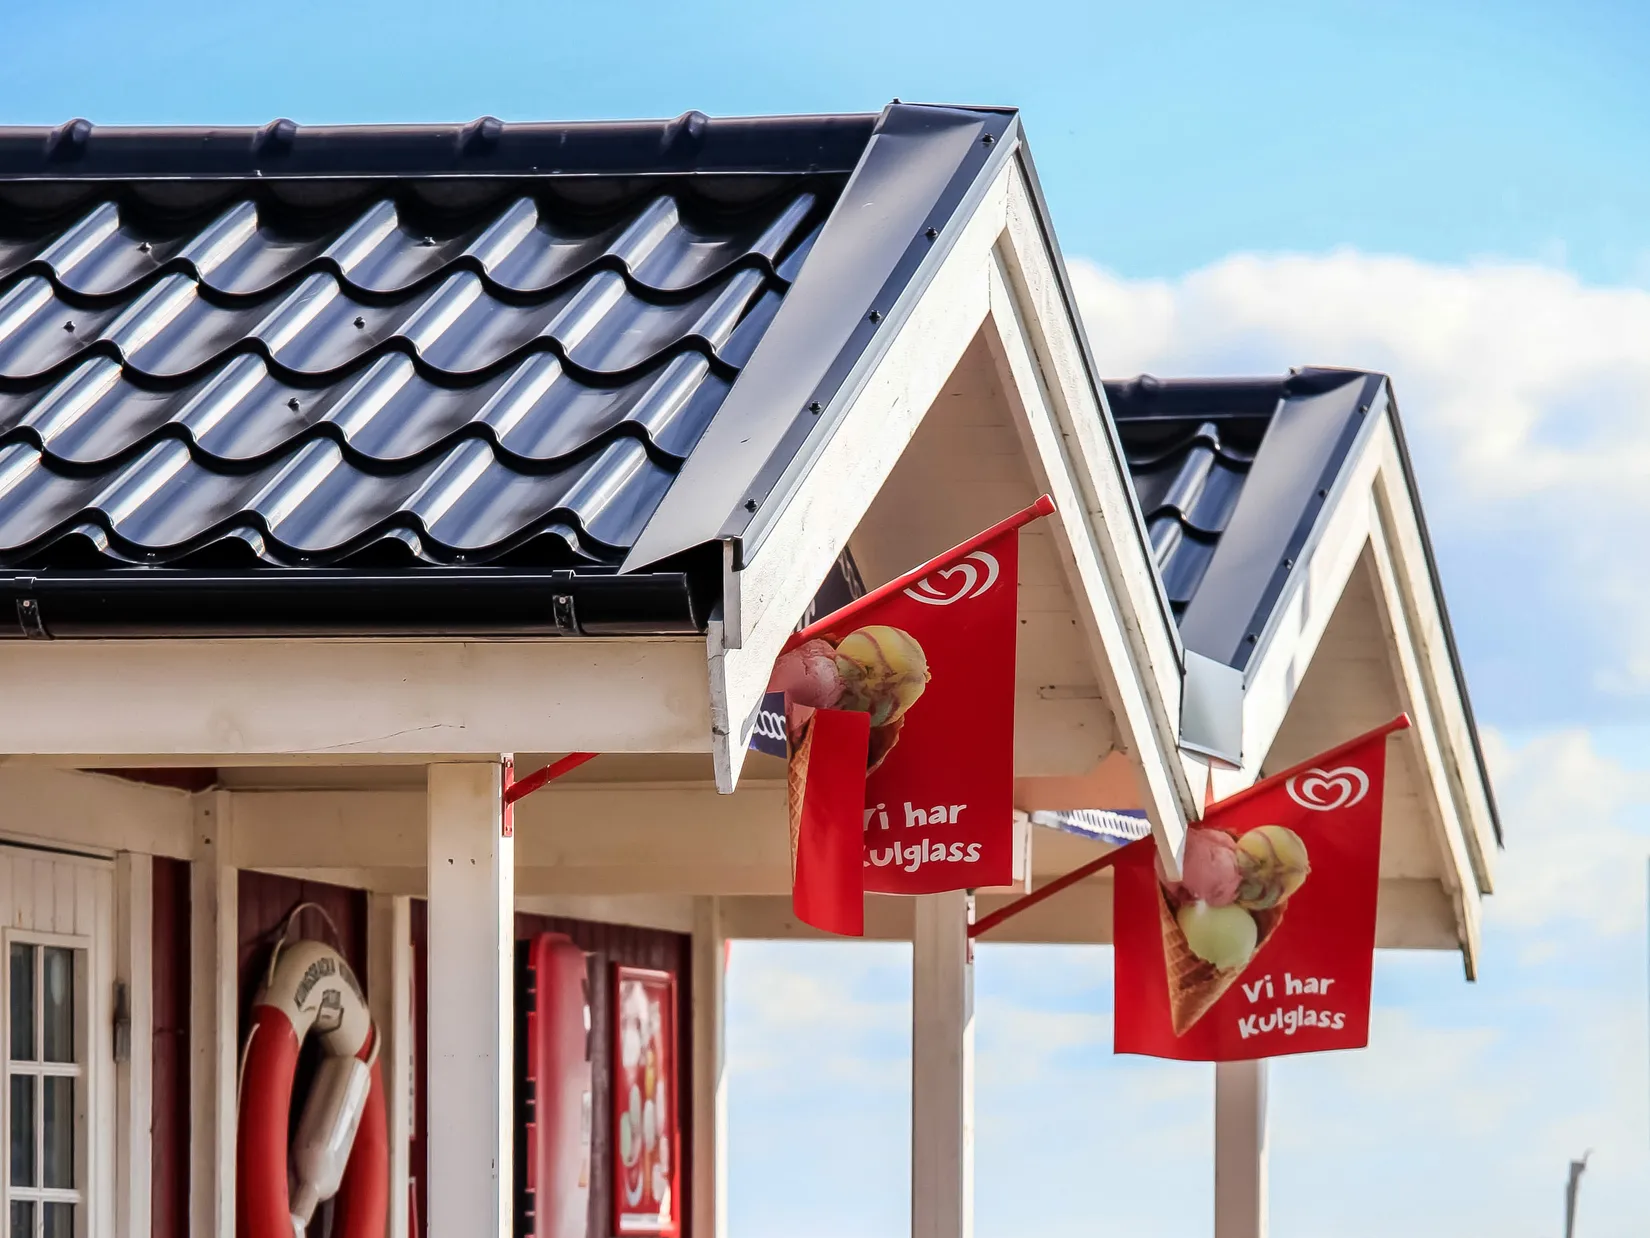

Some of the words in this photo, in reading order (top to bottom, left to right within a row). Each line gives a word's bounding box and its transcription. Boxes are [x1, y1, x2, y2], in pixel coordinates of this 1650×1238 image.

[903, 801, 968, 828] har
[863, 838, 982, 873] ulglass
[1241, 974, 1274, 1004] Vi
[1284, 972, 1335, 996] har
[1238, 1005, 1346, 1040] Kulglass
